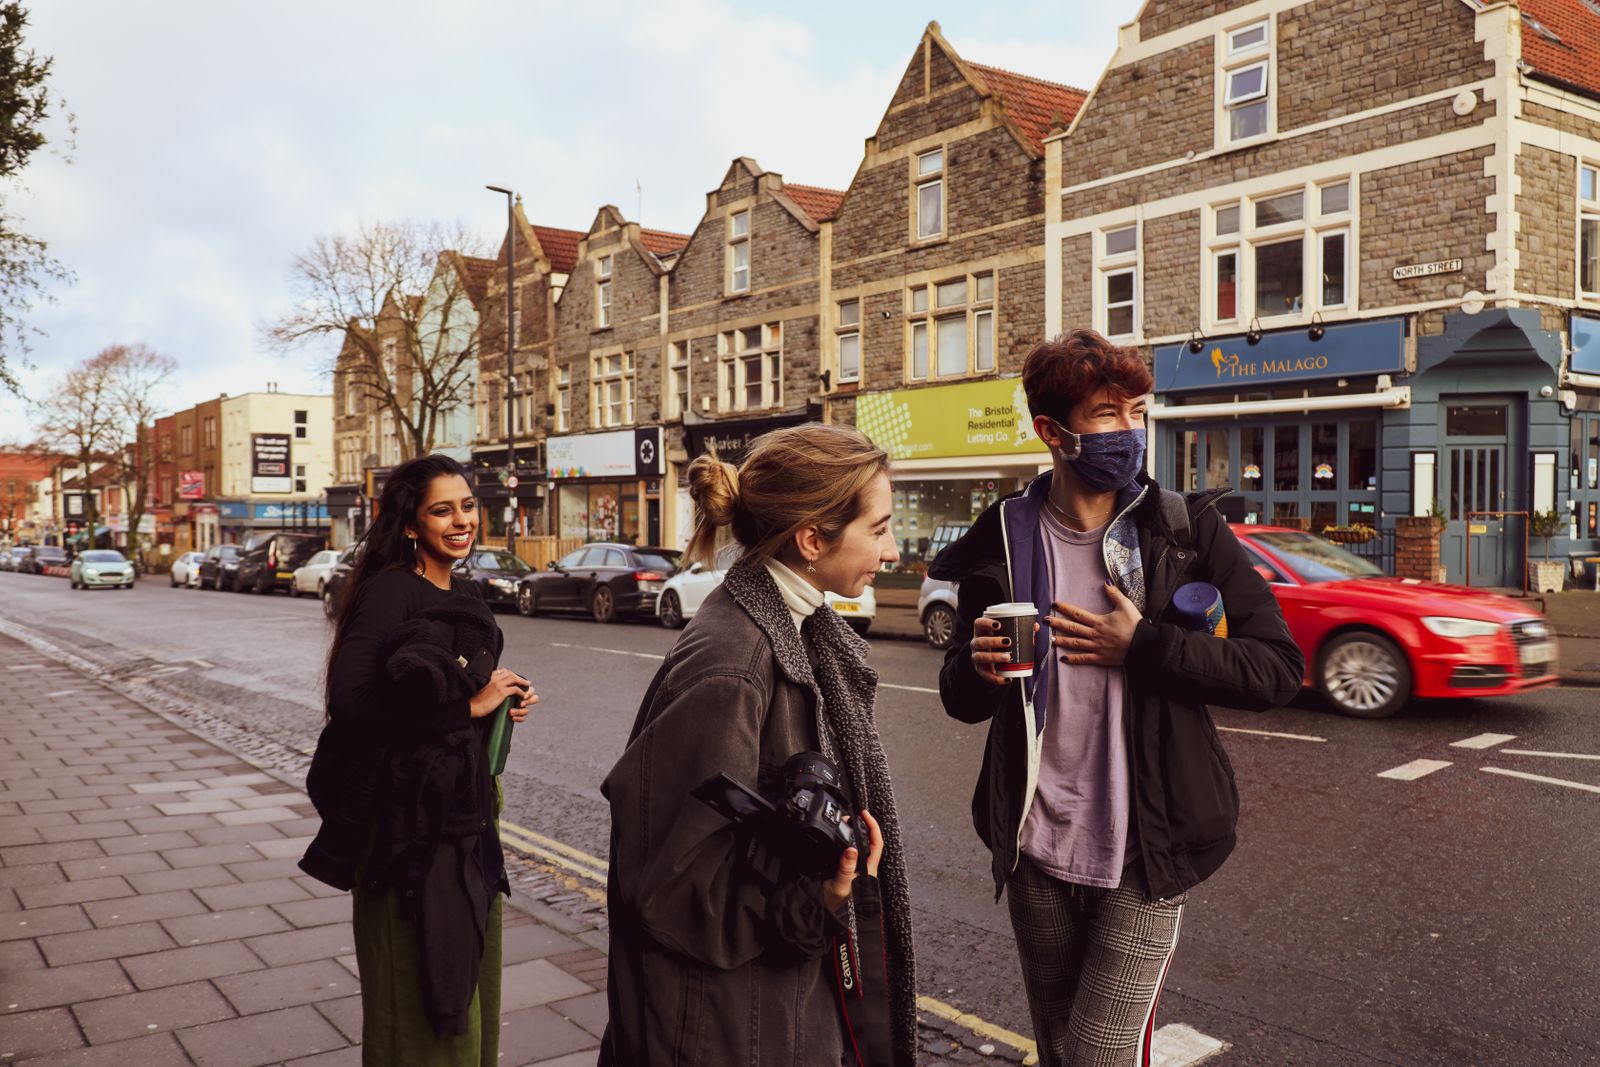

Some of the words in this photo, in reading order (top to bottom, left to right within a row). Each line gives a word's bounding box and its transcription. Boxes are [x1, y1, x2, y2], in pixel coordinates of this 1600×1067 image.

[1395, 266, 1424, 278] NORTH
[1427, 260, 1460, 273] STREET
[1228, 362, 1257, 377] THE
[1262, 355, 1329, 375] MALAGO
[968, 407, 983, 418] The
[984, 405, 1013, 417] Bristol
[967, 417, 1015, 430] Residential
[967, 433, 994, 445] Letting
[840, 943, 853, 990] Canon
